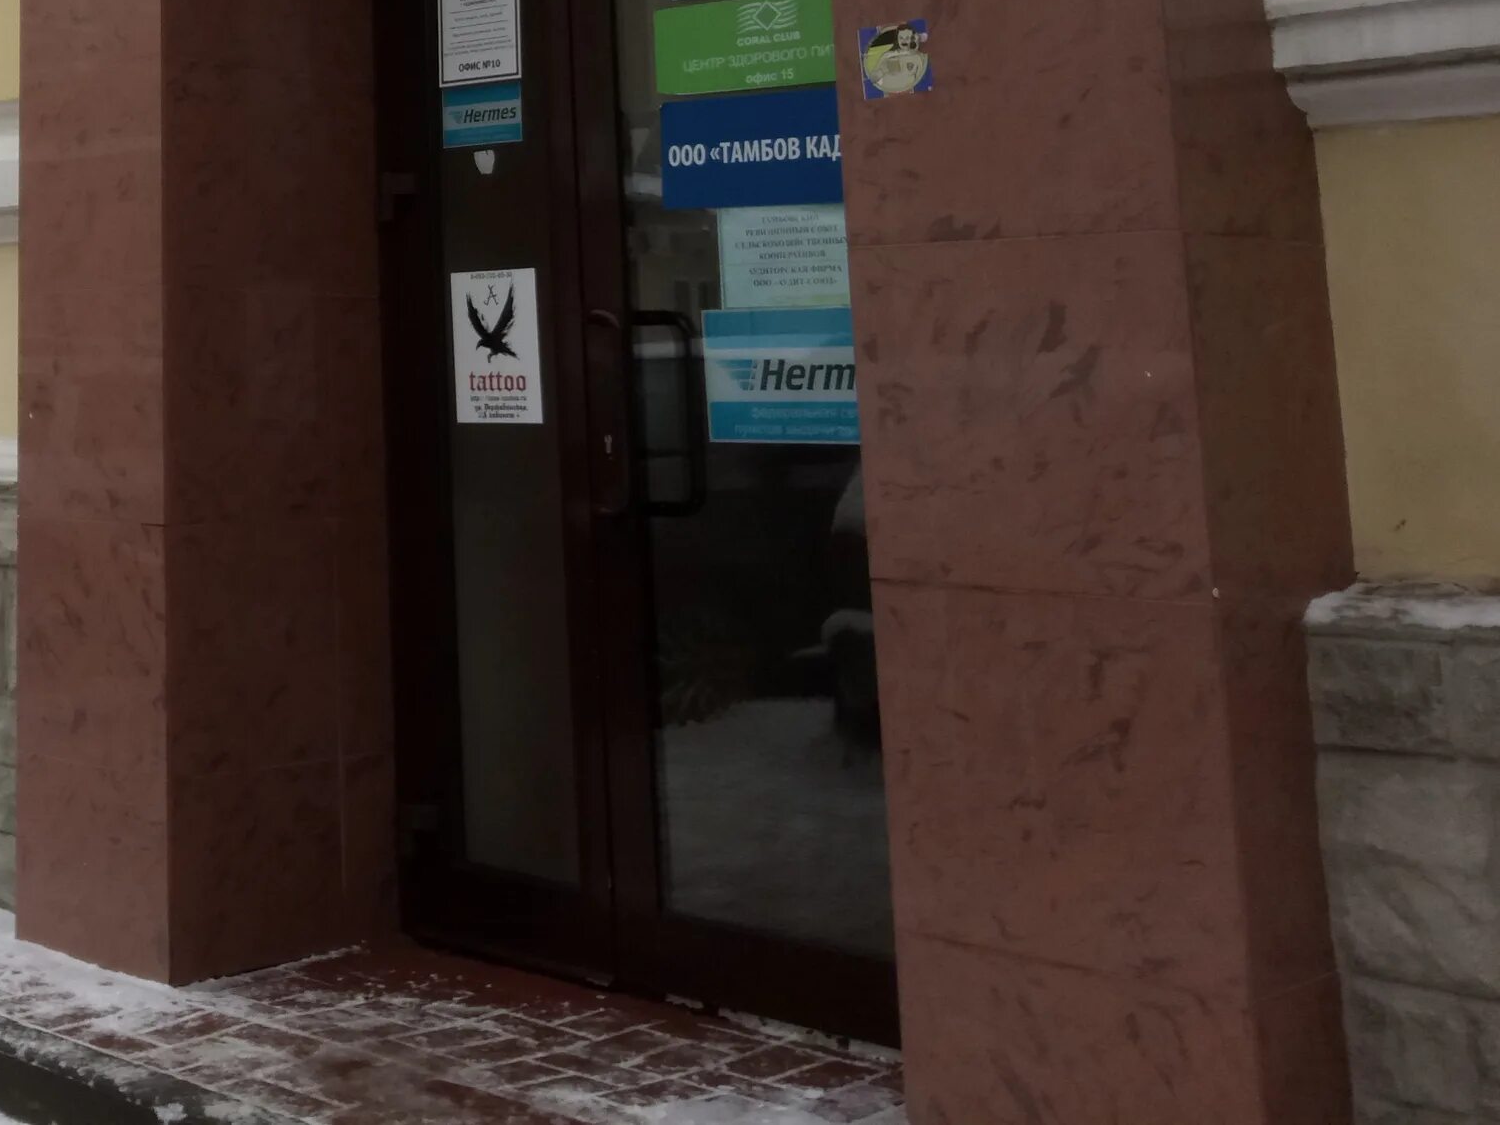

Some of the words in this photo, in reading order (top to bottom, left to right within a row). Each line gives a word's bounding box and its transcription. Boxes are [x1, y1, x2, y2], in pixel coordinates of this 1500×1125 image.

[736, 35, 772, 47] CORAL
[773, 30, 801, 41] CLUB
[458, 62, 482, 73] ОФИС
[682, 56, 726, 73] ЦЕНТР
[728, 46, 808, 68] ЗДОРОВОГО
[745, 72, 778, 85] офис
[781, 67, 795, 80] 15
[463, 107, 517, 123] Hermes
[668, 143, 706, 167] ООО
[709, 137, 801, 164] «ТАМБОВ
[469, 371, 526, 392] tattoo
[760, 359, 855, 391] Herm
